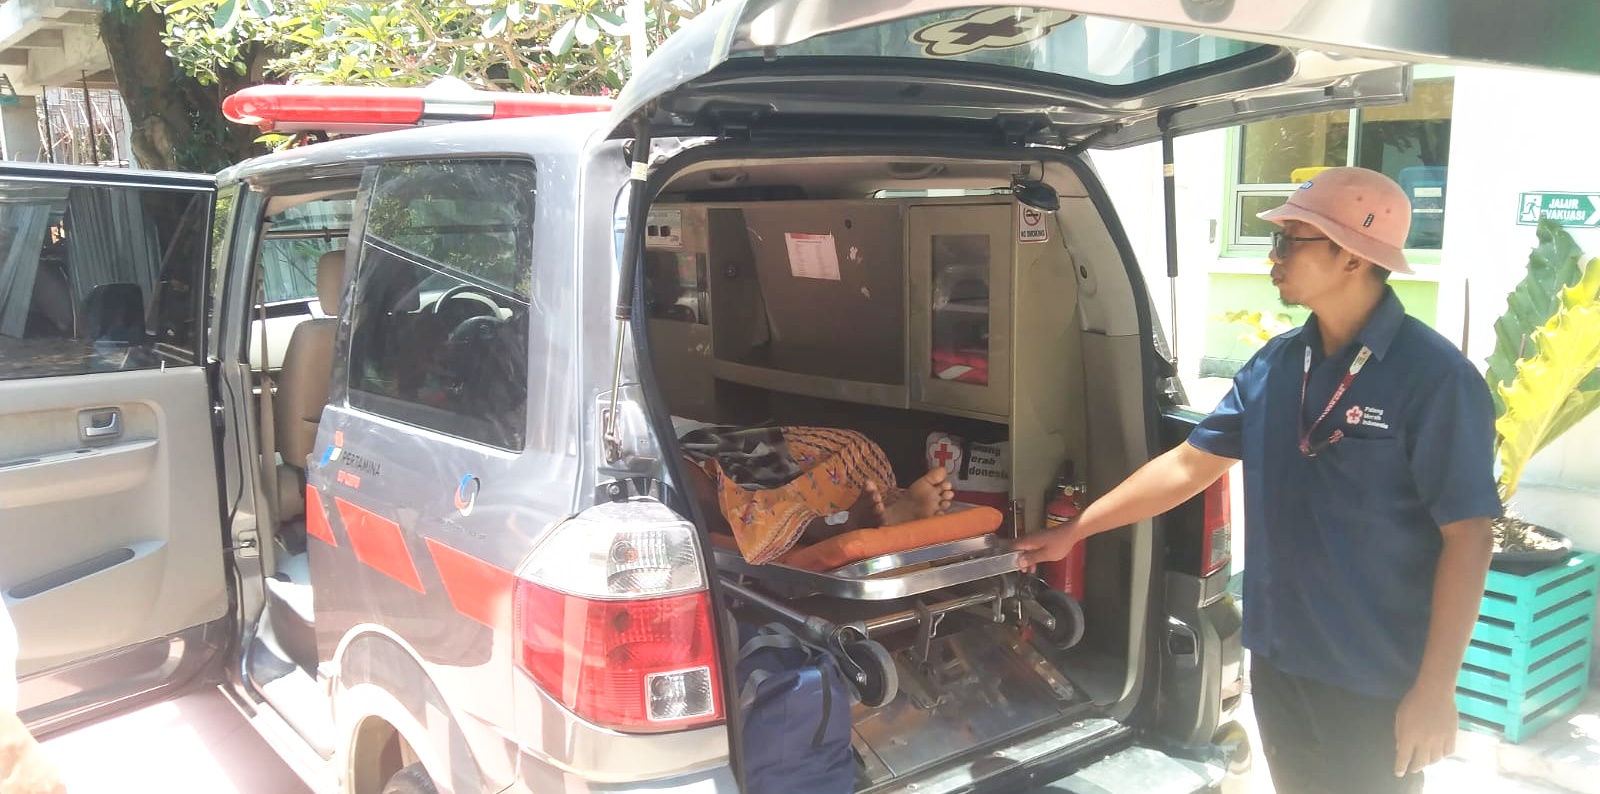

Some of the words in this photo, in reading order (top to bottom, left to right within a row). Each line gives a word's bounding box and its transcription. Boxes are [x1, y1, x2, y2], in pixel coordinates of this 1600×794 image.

[1548, 198, 1579, 209] JALUR
[1363, 412, 1382, 421] Merah
[343, 450, 382, 477] PERTAMINA
[970, 455, 996, 465] erah
